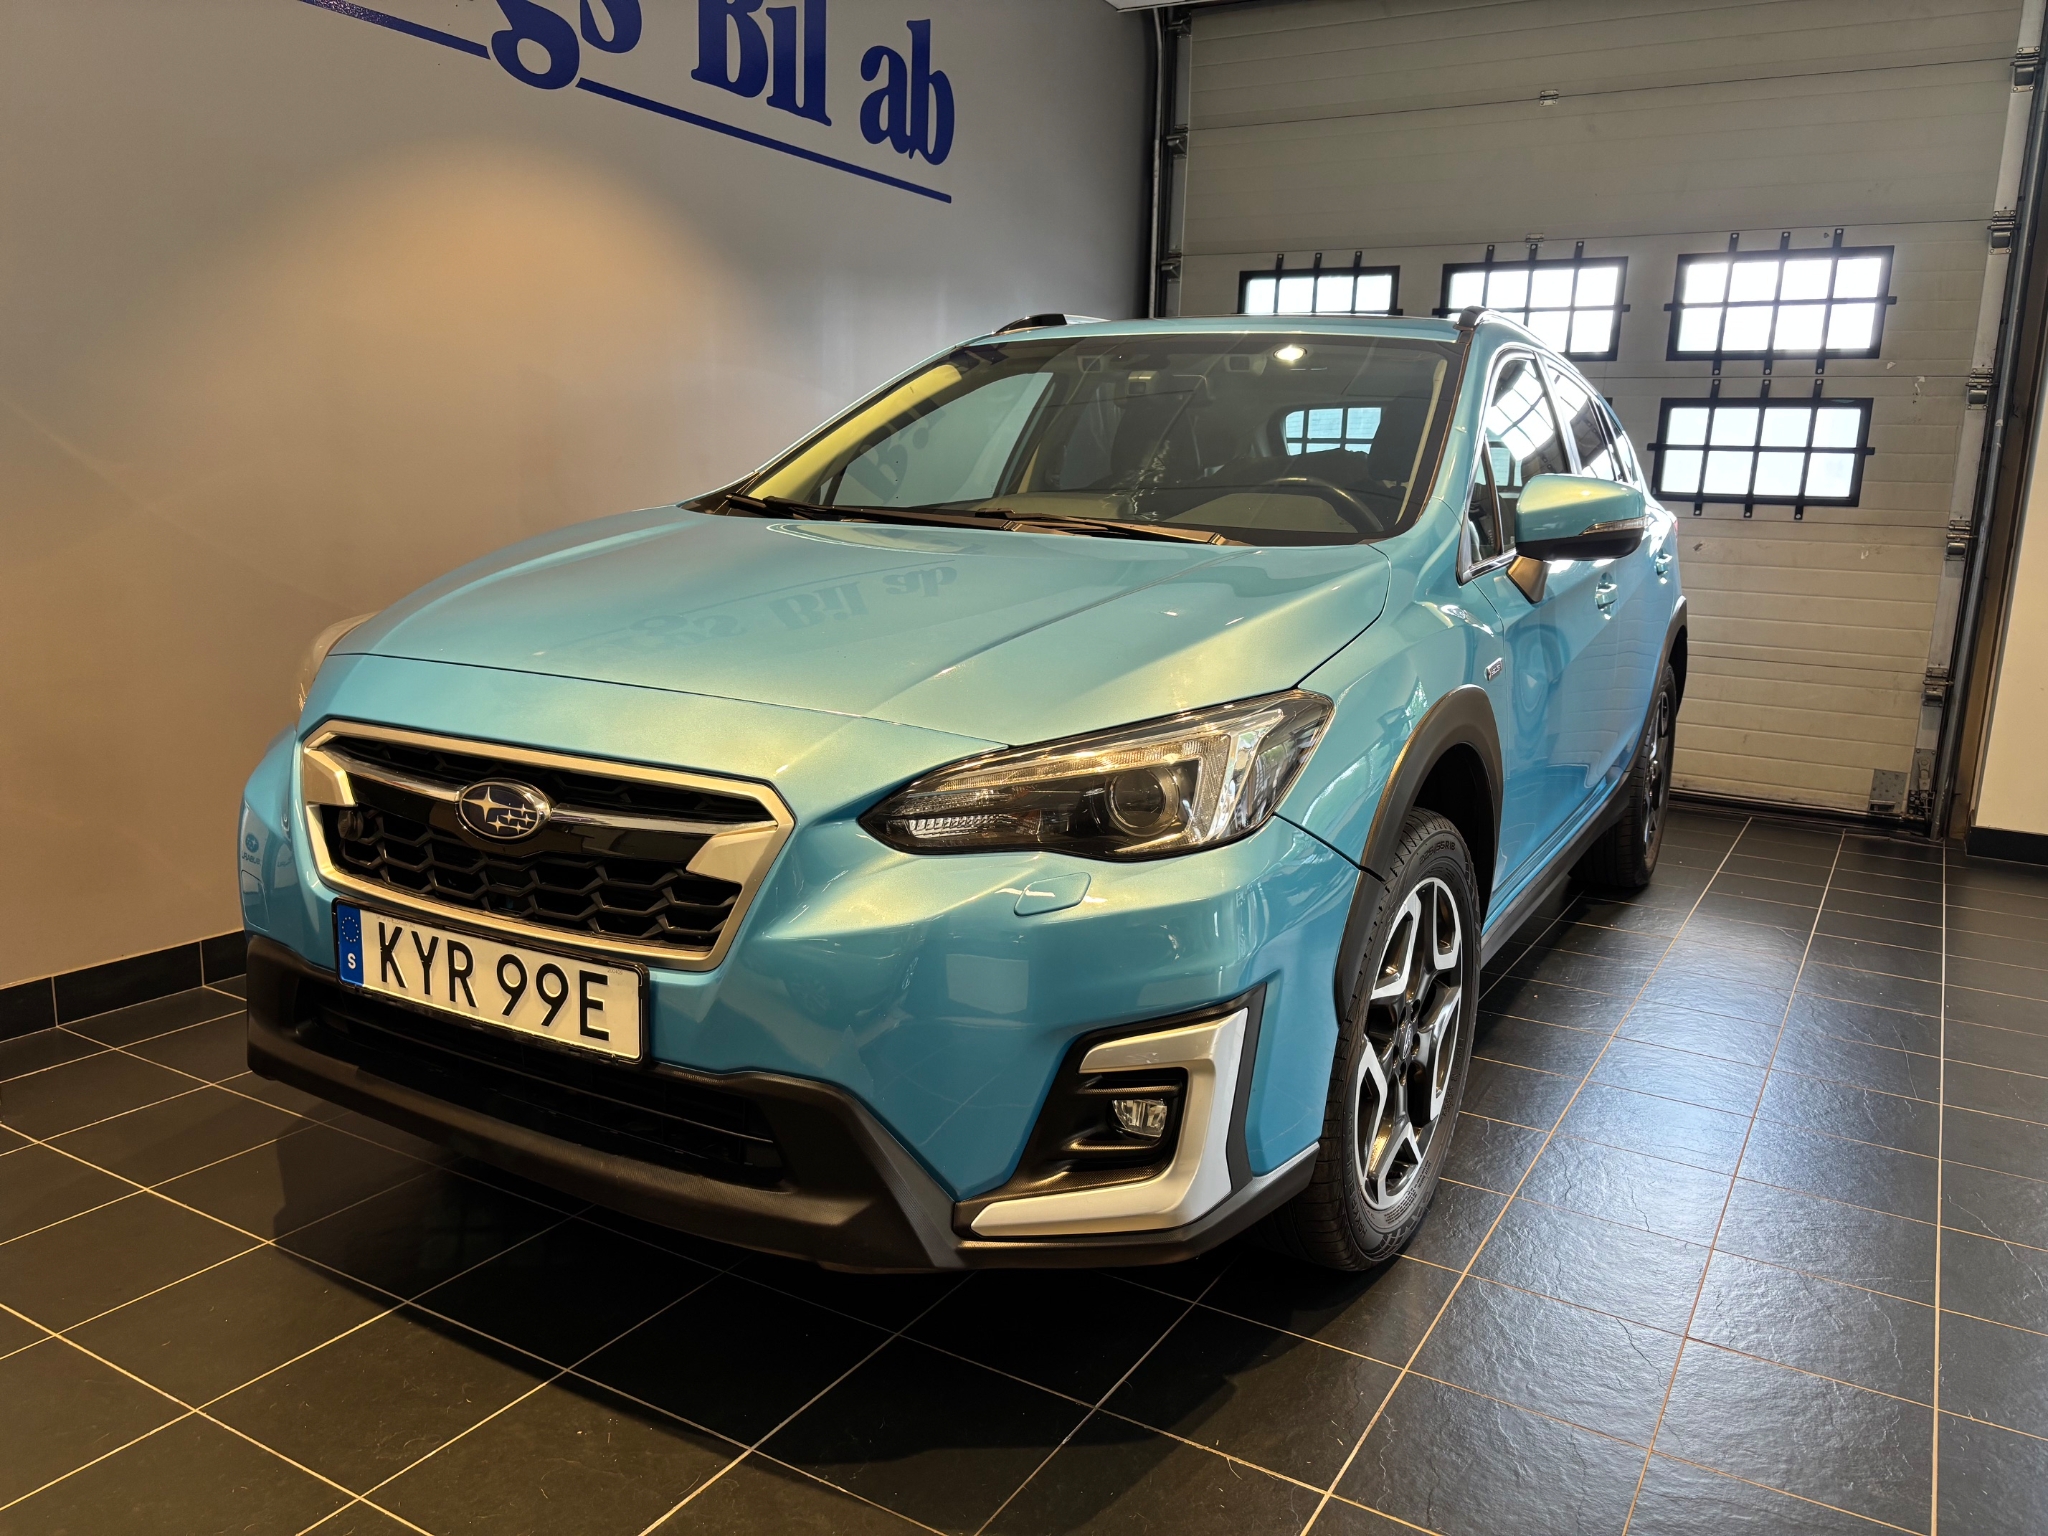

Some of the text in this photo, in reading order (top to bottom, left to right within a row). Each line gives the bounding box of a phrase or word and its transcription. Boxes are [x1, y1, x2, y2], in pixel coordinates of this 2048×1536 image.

[691, 0, 832, 127] Bil
[860, 18, 955, 166] ab
[347, 953, 356, 969] S
[378, 921, 610, 1041] KYR 99E
